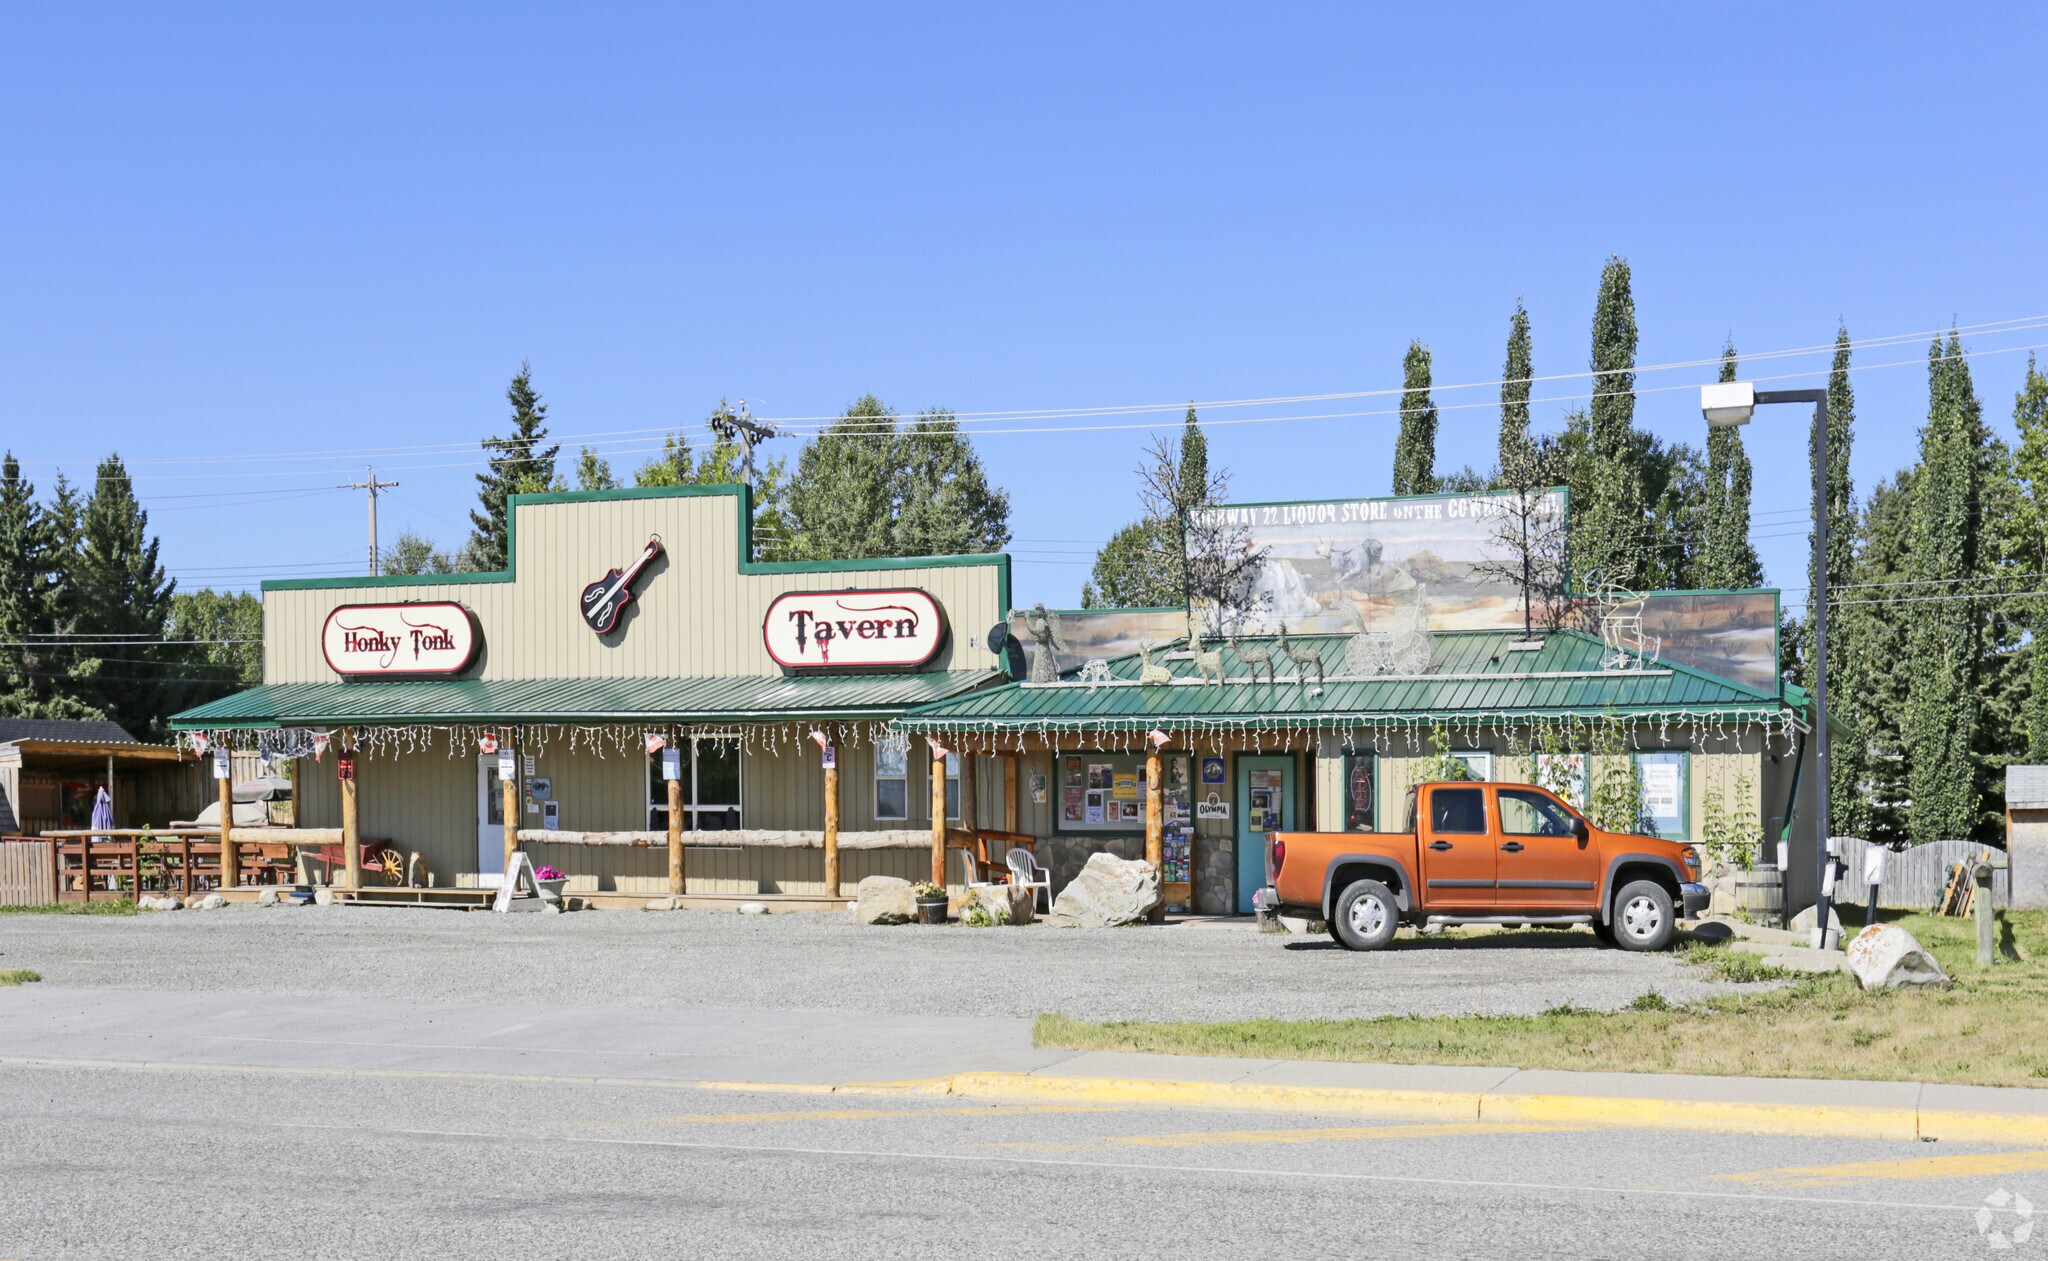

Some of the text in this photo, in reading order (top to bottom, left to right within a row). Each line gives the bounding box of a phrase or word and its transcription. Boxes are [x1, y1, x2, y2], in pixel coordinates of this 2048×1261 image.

[1262, 507, 1278, 525] 22
[1283, 504, 1336, 526] LIQUOR
[1341, 502, 1387, 522] STORE
[342, 621, 456, 667] Honky Tonk
[789, 606, 918, 659] Tavern
[1199, 805, 1227, 815] OLYMPIA
